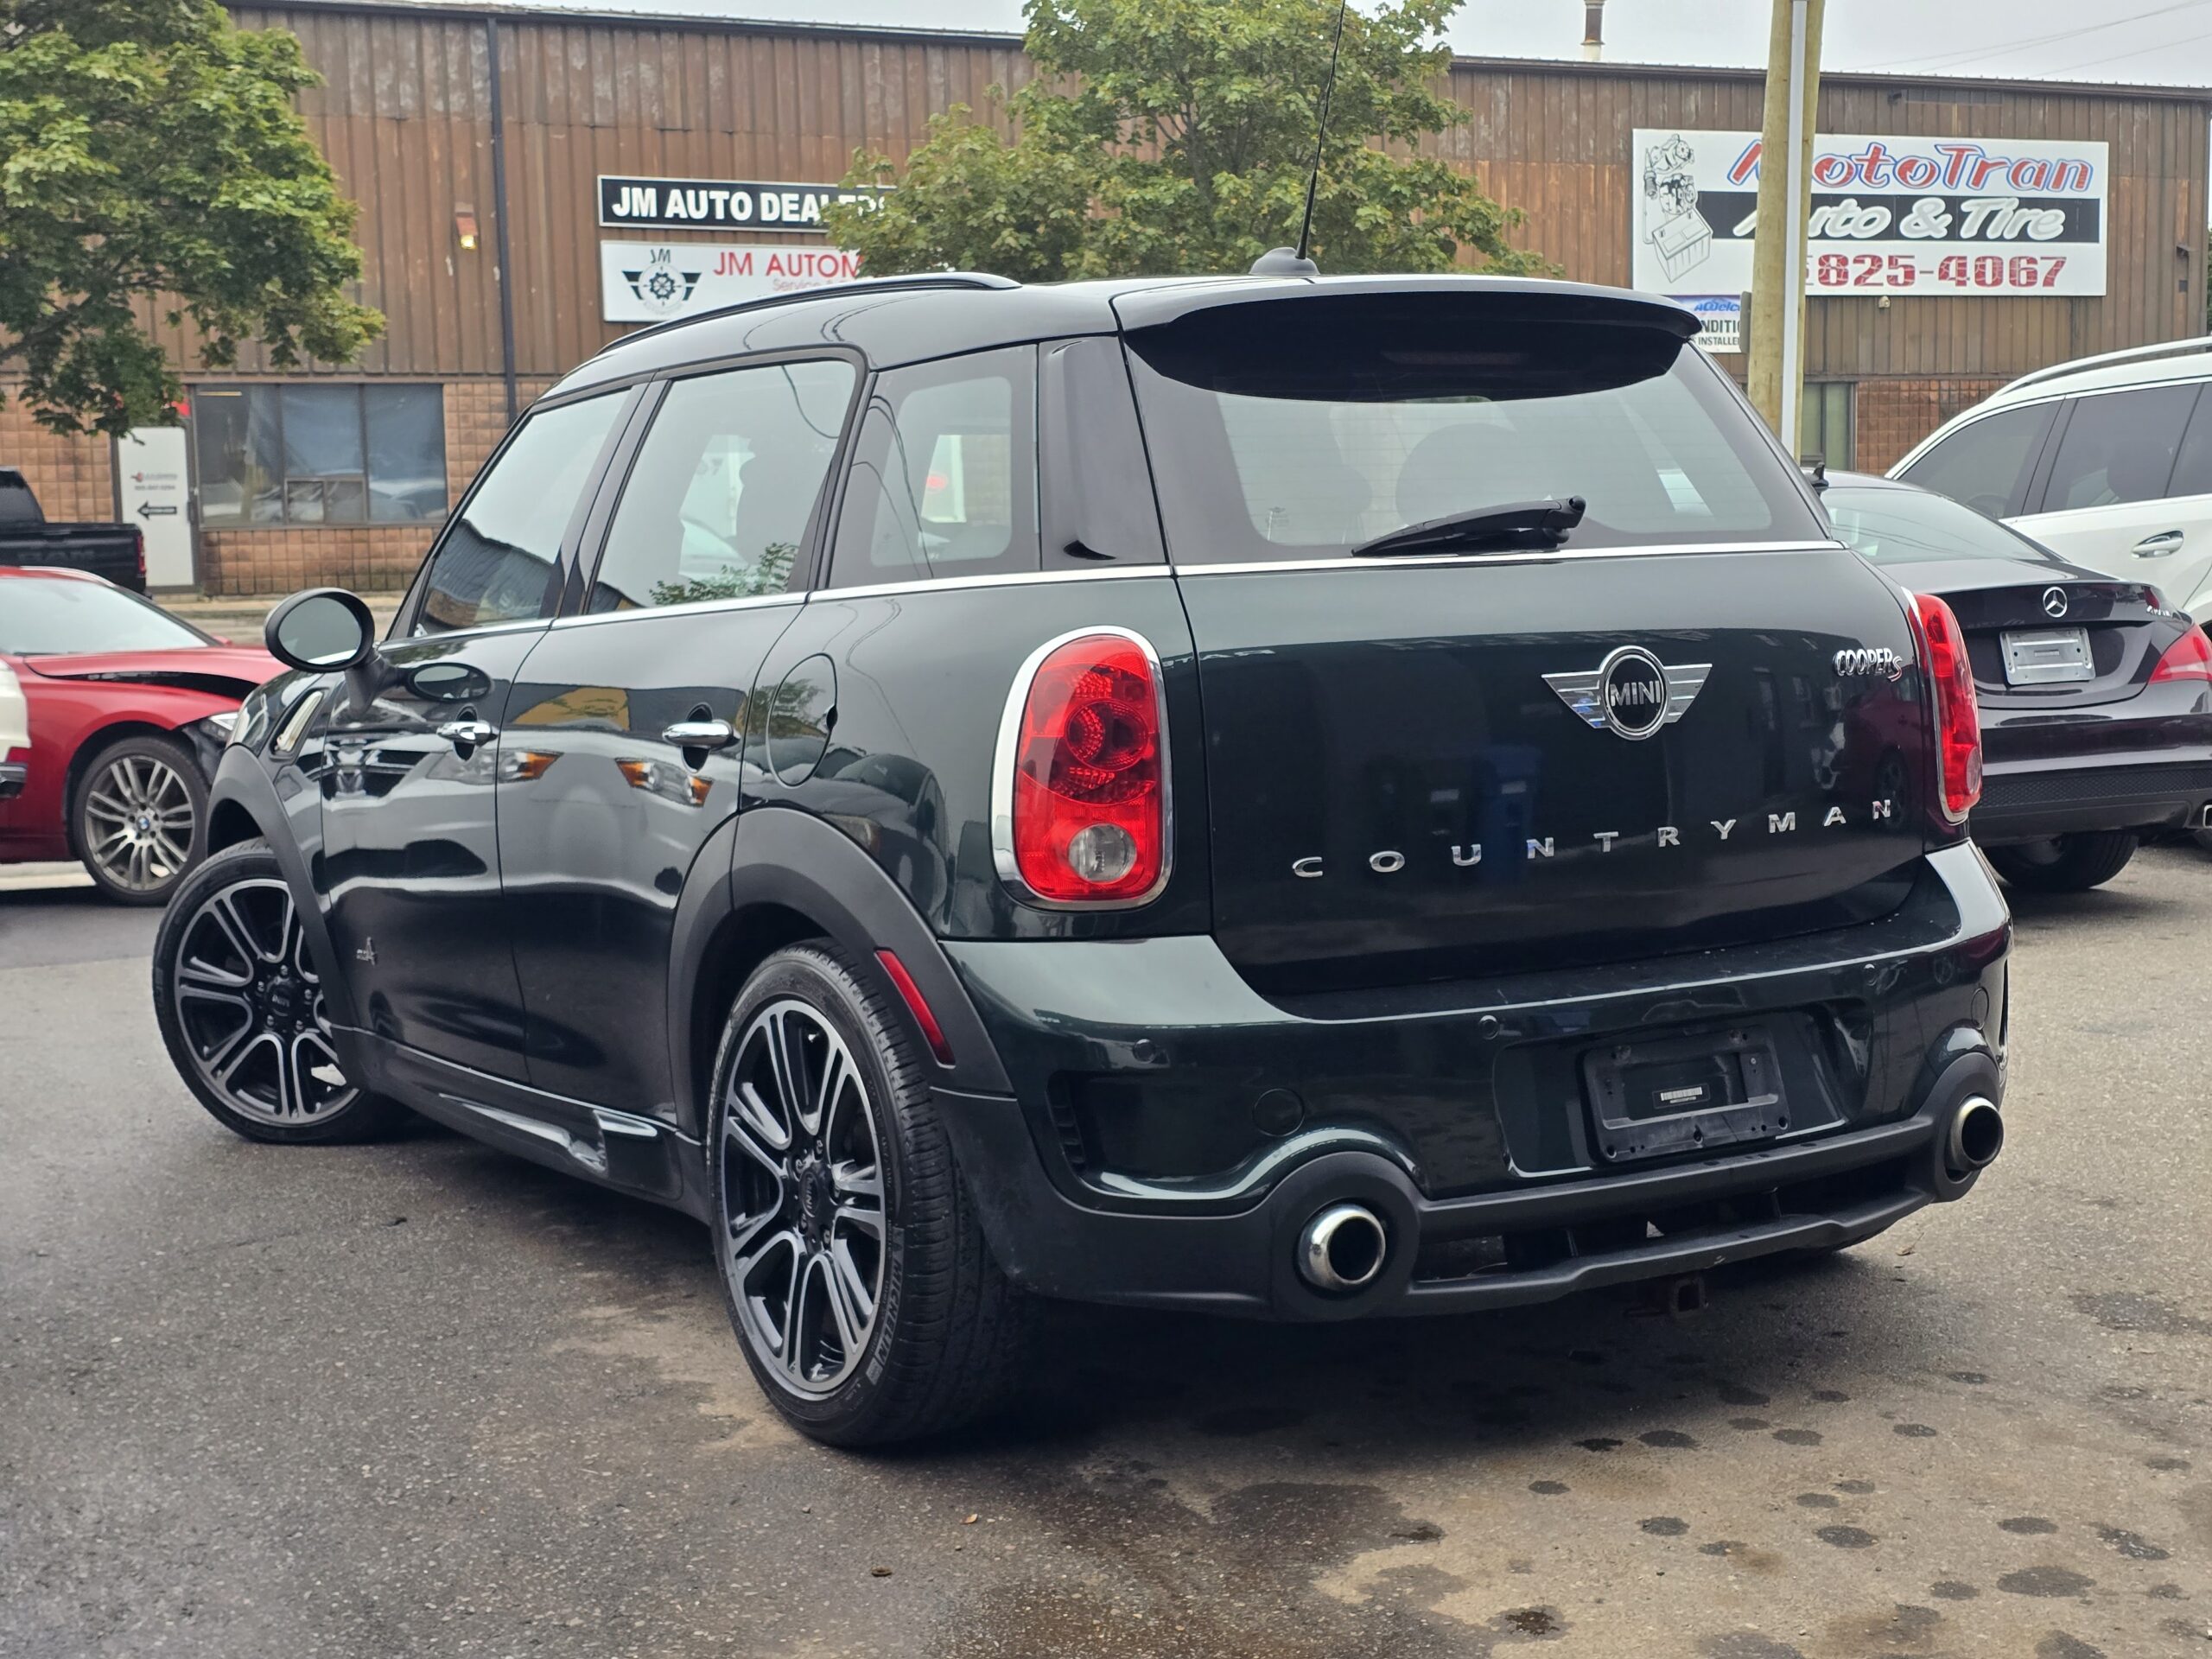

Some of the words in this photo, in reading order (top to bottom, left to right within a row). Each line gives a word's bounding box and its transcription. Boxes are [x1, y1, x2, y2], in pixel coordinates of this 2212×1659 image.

[612, 187, 657, 218] JM
[664, 189, 753, 220] AUTO
[1899, 197, 1953, 238] &
[1960, 197, 2066, 241] Tire
[650, 248, 671, 264] JM
[713, 251, 753, 276] JM
[1698, 336, 1740, 346] INSTALLE
[1610, 680, 1661, 707] MINI
[1292, 799, 1891, 878] COUNTRYMAN
[877, 1258, 902, 1364] MICHELIN
